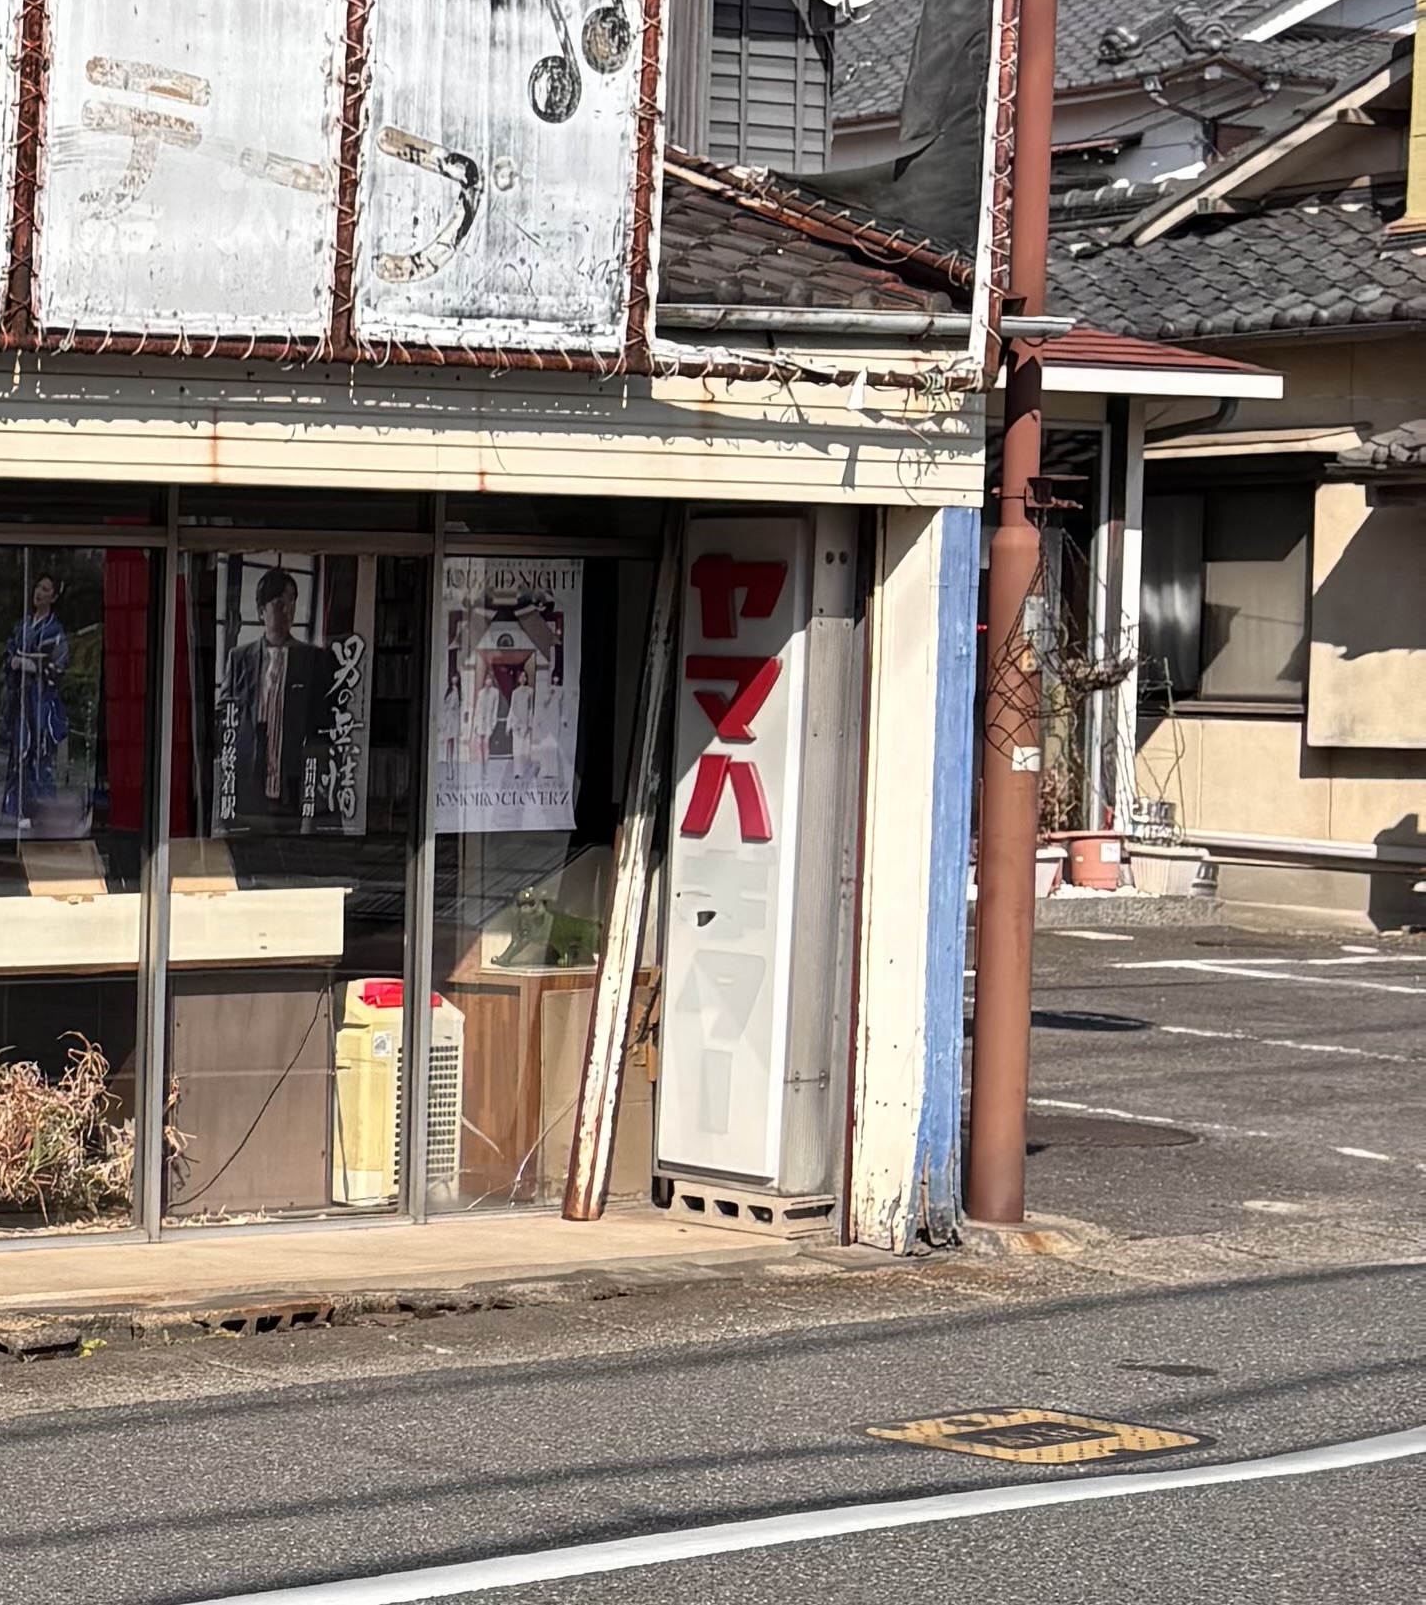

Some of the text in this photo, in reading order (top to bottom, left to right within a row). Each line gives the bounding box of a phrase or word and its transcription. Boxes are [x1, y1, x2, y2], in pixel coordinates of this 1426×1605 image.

[317, 634, 365, 818] 男の無情
[679, 553, 789, 843] ヤマハ
